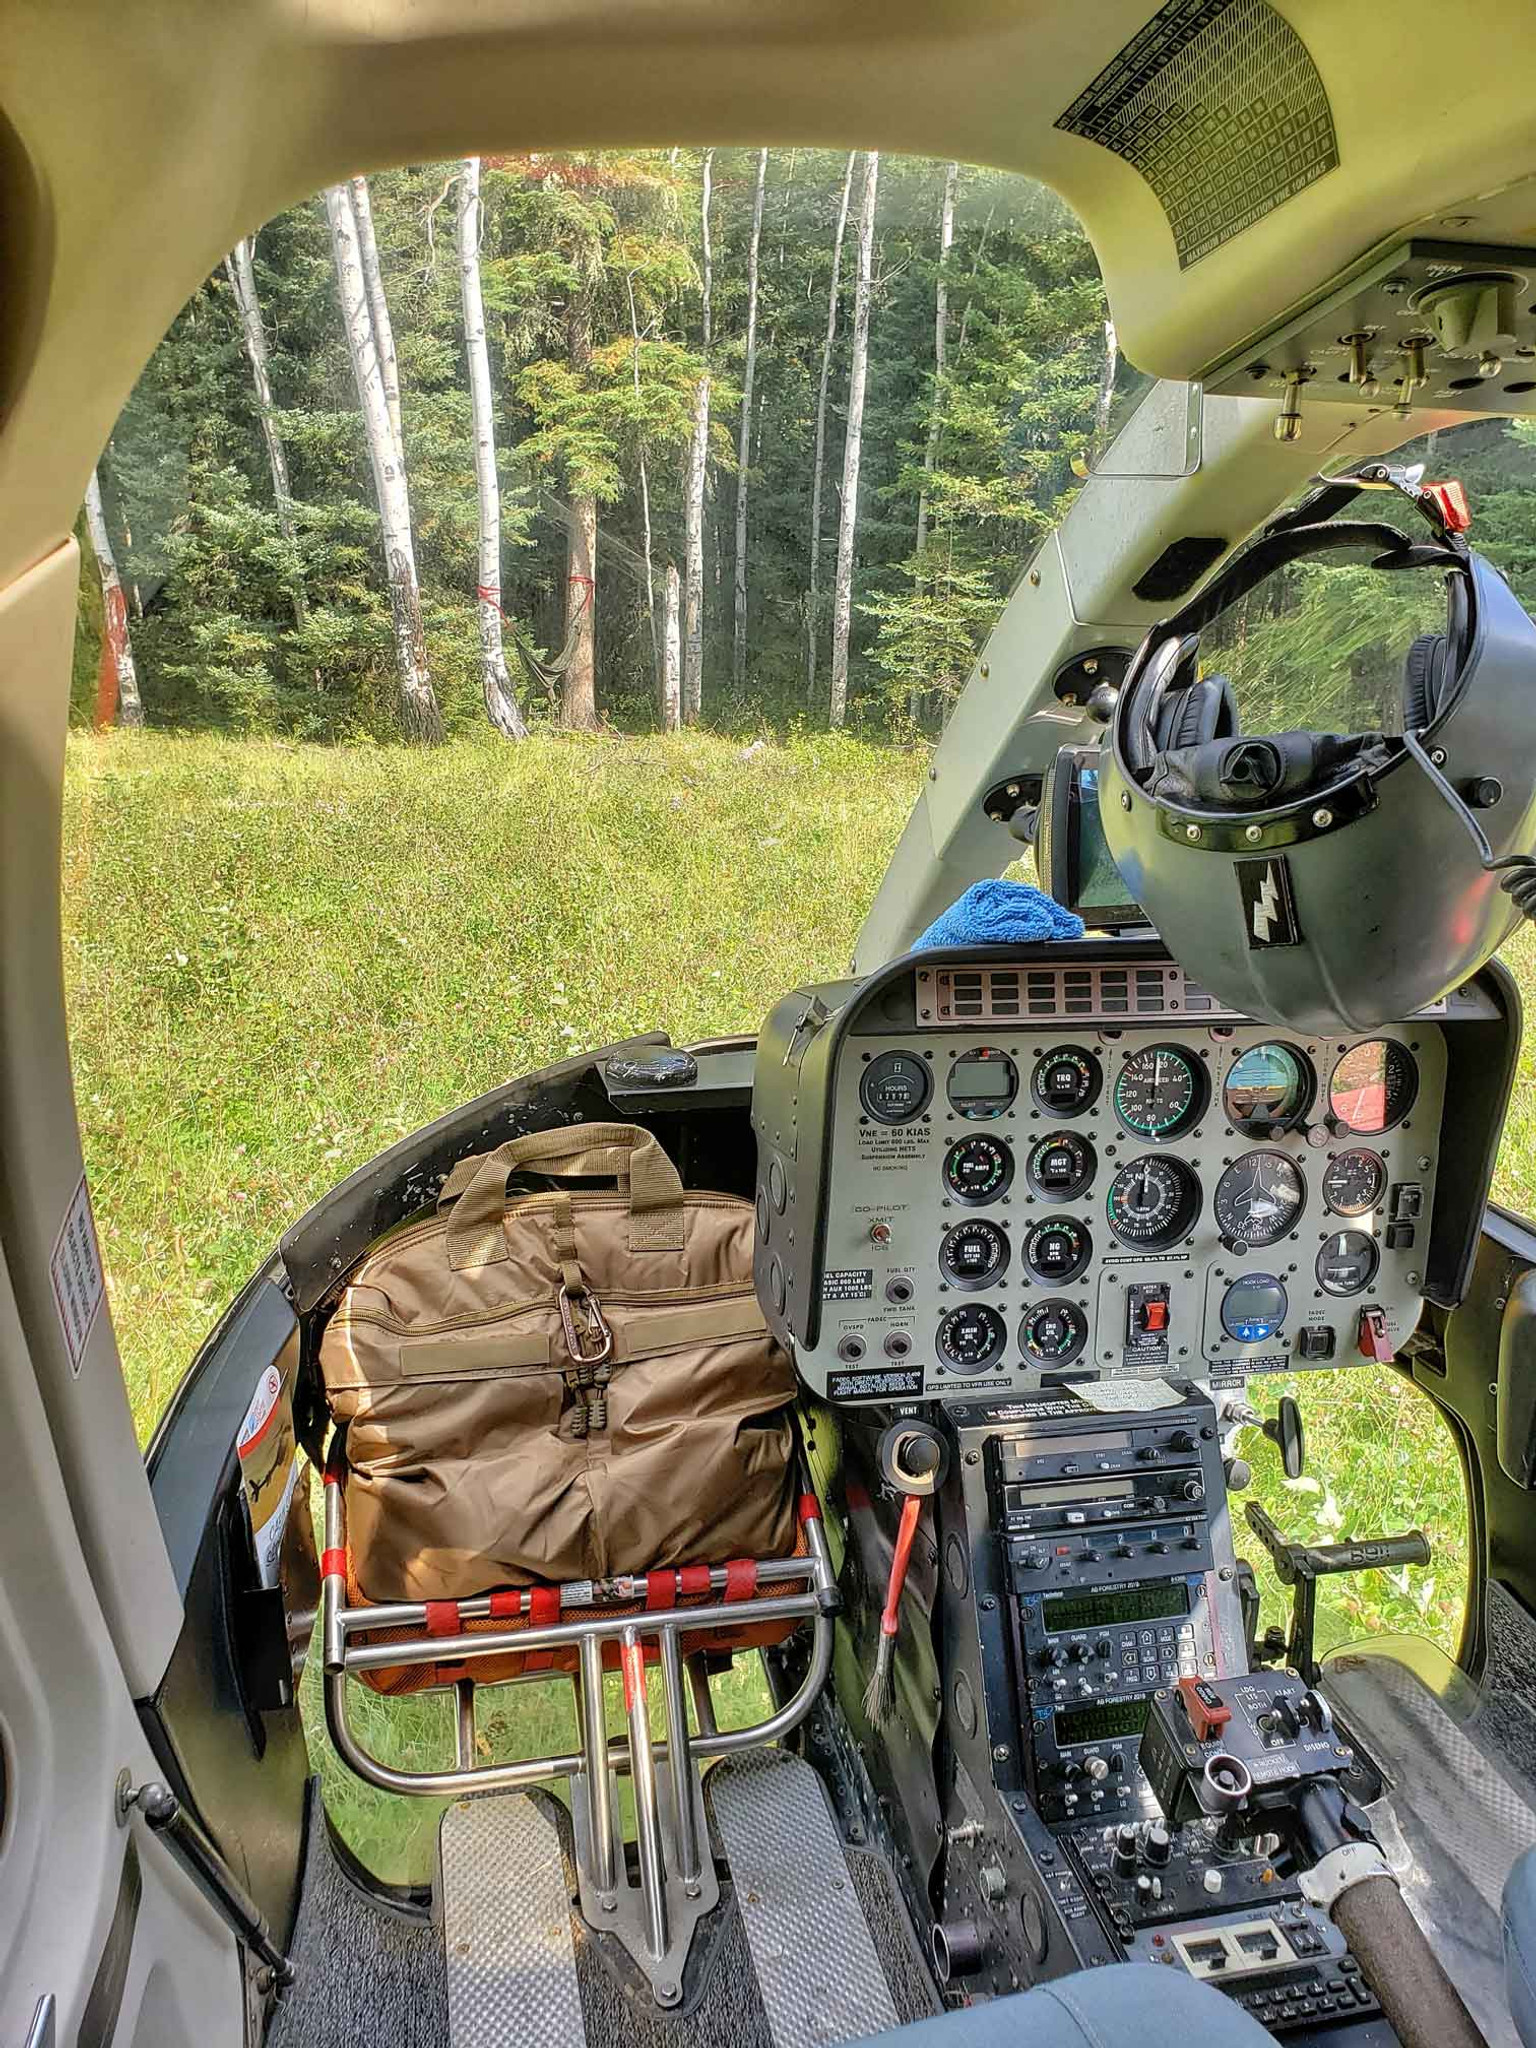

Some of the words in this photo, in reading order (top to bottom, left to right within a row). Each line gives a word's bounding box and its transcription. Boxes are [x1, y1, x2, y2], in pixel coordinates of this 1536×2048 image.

[1092, 68, 1136, 110] PRESSURE
[1129, 33, 1169, 72] ALTITUDE
[1183, 235, 1222, 263] MAXIMUM
[1217, 199, 1277, 241] AUTOROTATION
[1304, 161, 1329, 181] KIAS
[1389, 1065, 1395, 1073] 2
[860, 1129, 877, 1137] VNE
[892, 1128, 903, 1136] 60
[906, 1128, 931, 1136] KIAS
[1051, 1158, 1067, 1166] MGT
[1226, 1212, 1234, 1220] N
[964, 1245, 980, 1253] FUEL
[1212, 1380, 1241, 1388] MIRROR
[1025, 1398, 1070, 1409] HELICOPTER
[900, 1406, 917, 1415] VENT
[1117, 1533, 1123, 1544] 2
[1183, 1526, 1189, 1537] 0
[1099, 1583, 1126, 1592] FORESTRY
[1071, 1633, 1088, 1641] GUARD
[1274, 1687, 1295, 1696] START
[1105, 1695, 1133, 1703] FORESTRY
[1248, 1702, 1267, 1710] BOTH
[1303, 1741, 1330, 1752] DISENG
[1342, 1846, 1356, 1857] OFF
